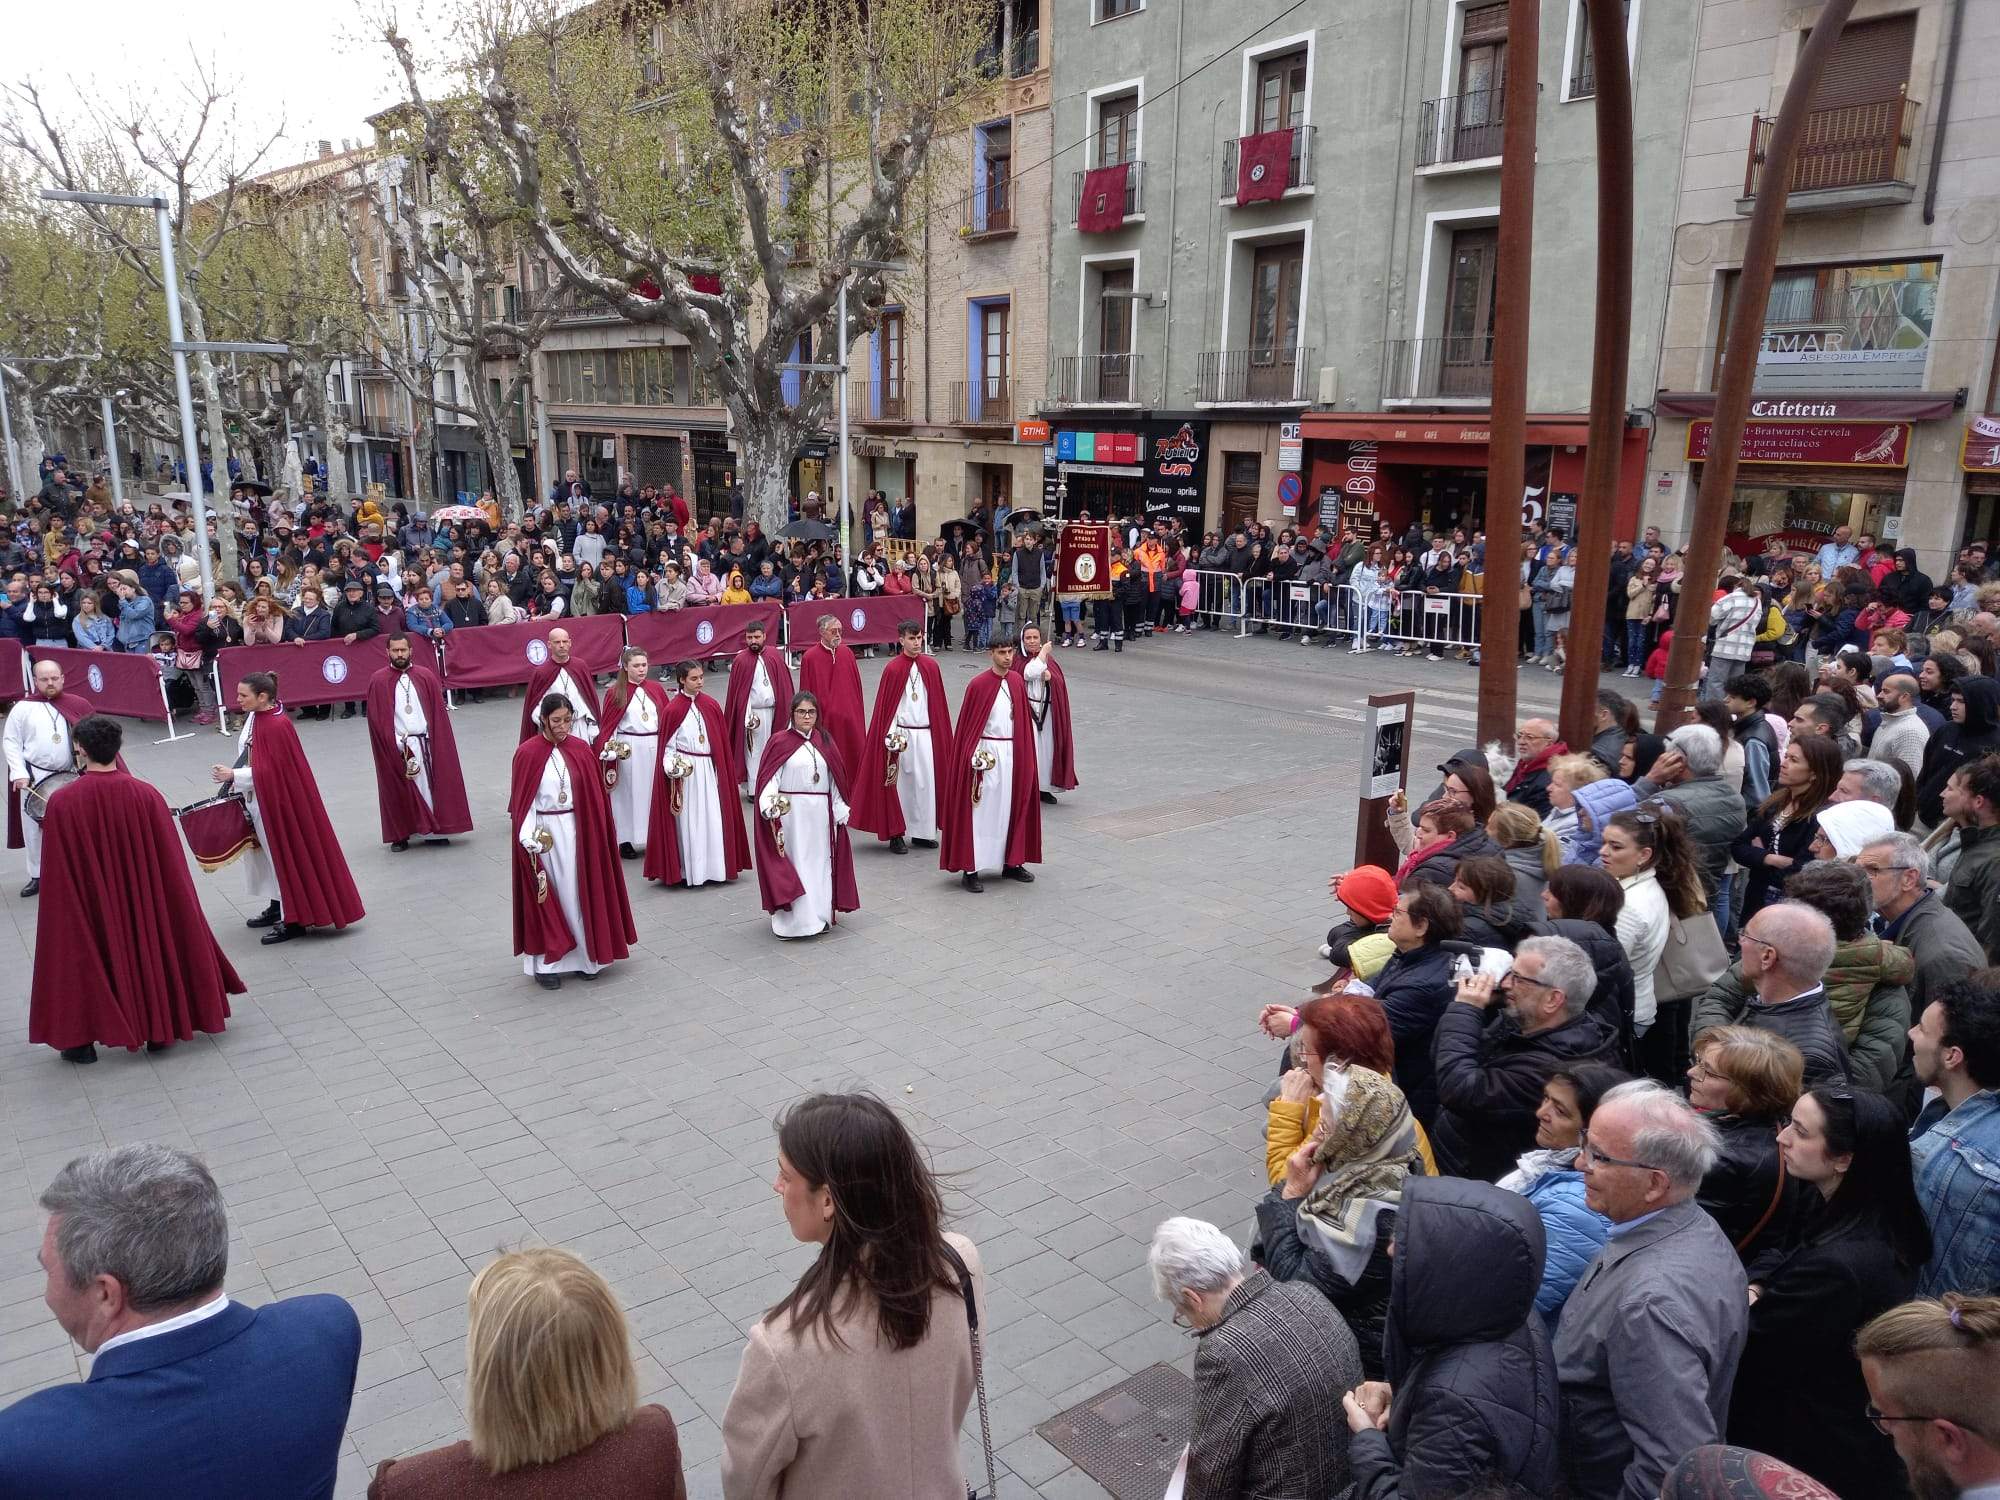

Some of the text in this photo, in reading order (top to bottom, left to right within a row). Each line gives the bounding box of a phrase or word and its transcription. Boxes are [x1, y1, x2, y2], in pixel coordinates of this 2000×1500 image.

[1022, 427, 1046, 436] STIHL
[1293, 425, 1300, 438] P
[1754, 440, 1776, 448] para
[1757, 450, 1802, 460] Campera
[1346, 441, 1378, 494] BAR
[1148, 486, 1172, 494] PIAGGIO
[1177, 487, 1198, 496] aprilia
[1177, 505, 1200, 513] DERBI
[1781, 518, 1836, 535] CAFETERI
